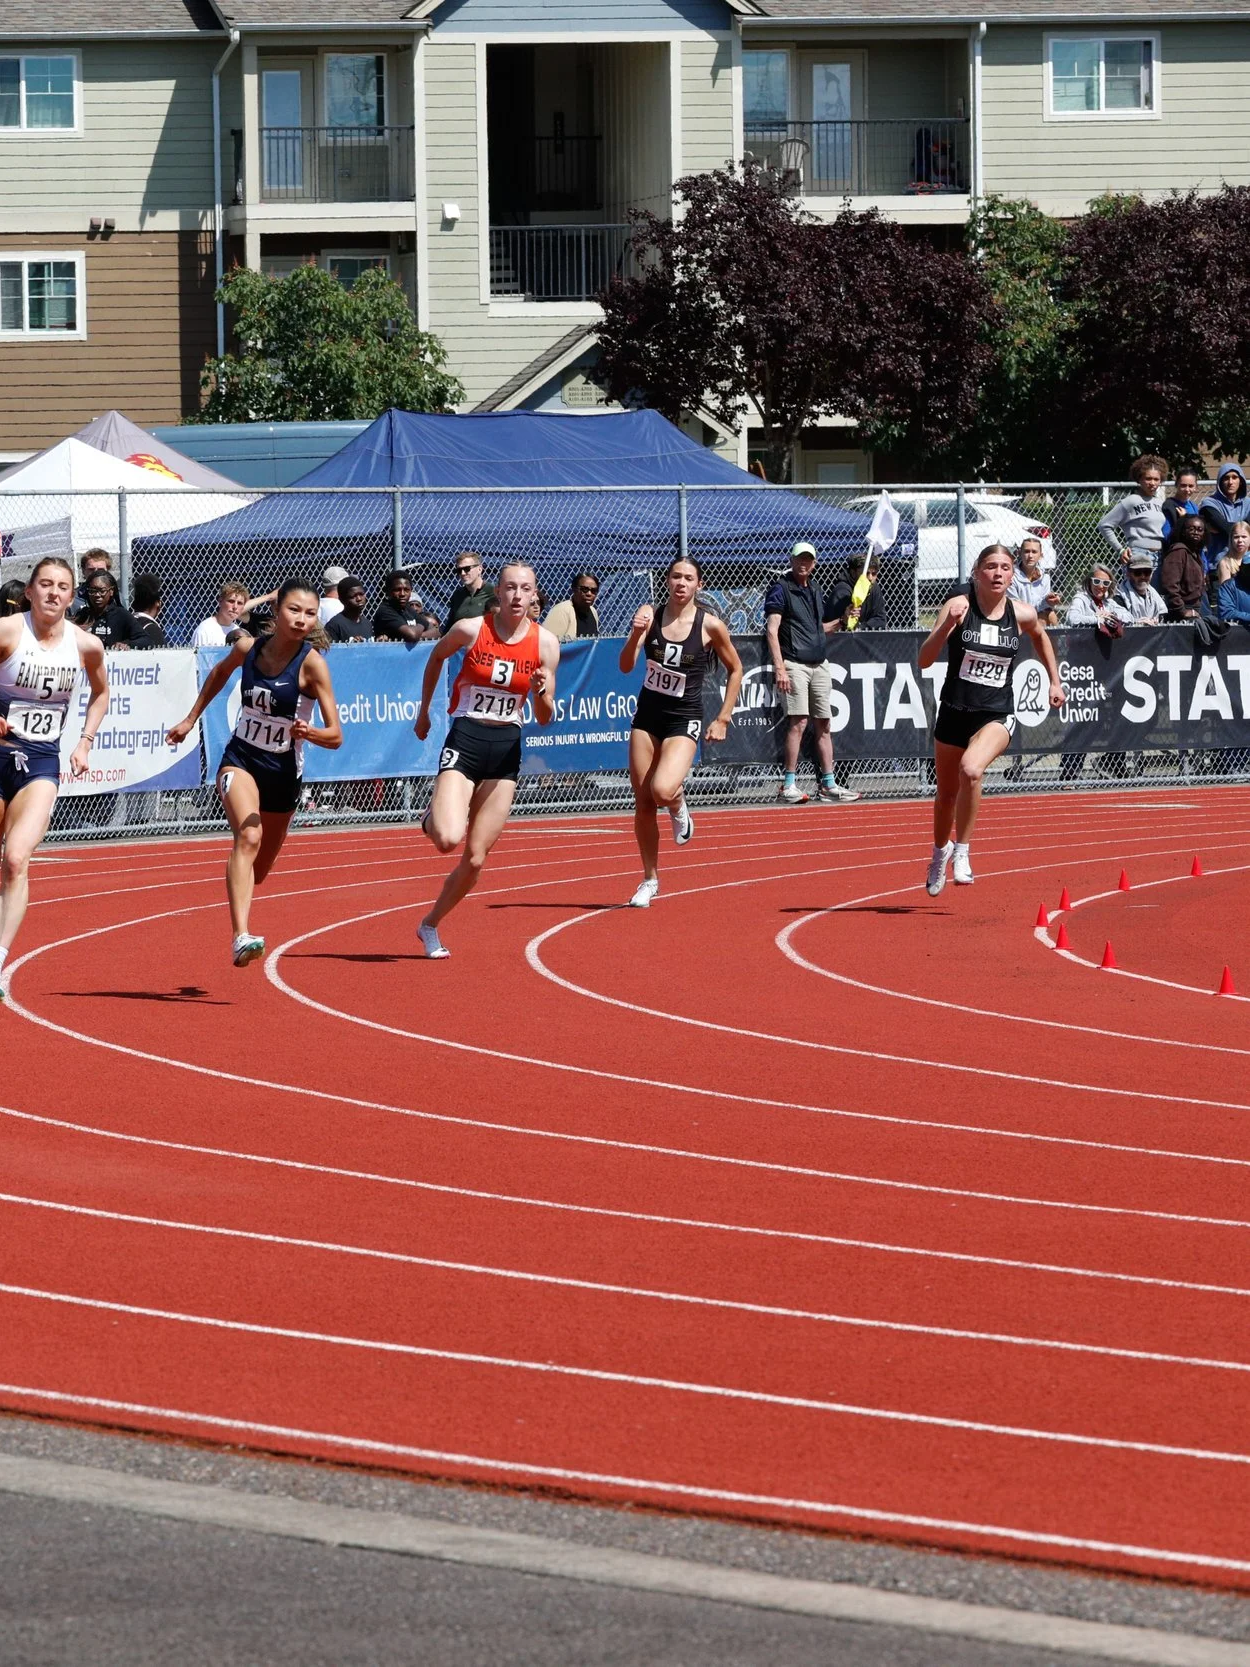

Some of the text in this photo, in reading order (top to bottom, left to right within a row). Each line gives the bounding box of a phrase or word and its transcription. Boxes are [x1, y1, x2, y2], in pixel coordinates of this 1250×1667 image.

[962, 630, 1019, 650] OTLLO
[667, 646, 677, 665] 2
[80, 661, 161, 687] nthwest
[495, 663, 509, 684] 3
[647, 668, 681, 691] 2197
[967, 659, 1004, 681] 1829
[1058, 661, 1094, 680] Gesa
[40, 678, 53, 699] 5
[830, 661, 950, 733] STAT
[1061, 682, 1107, 702] Credit
[1121, 655, 1250, 723] STAT
[78, 692, 131, 717] Srts
[255, 690, 267, 712] 4
[319, 694, 372, 724] edit
[473, 692, 517, 716] 2719
[522, 691, 638, 724] DIS LAW GRO
[22, 711, 53, 735] 123
[1059, 702, 1099, 723] Union
[81, 723, 178, 755] hotograph
[244, 718, 285, 746] 1714
[526, 736, 553, 747] SERIOUS
[555, 734, 578, 745] INJURY
[579, 732, 585, 744] &
[585, 731, 623, 743] WRONGFUL
[691, 721, 699, 738] 2
